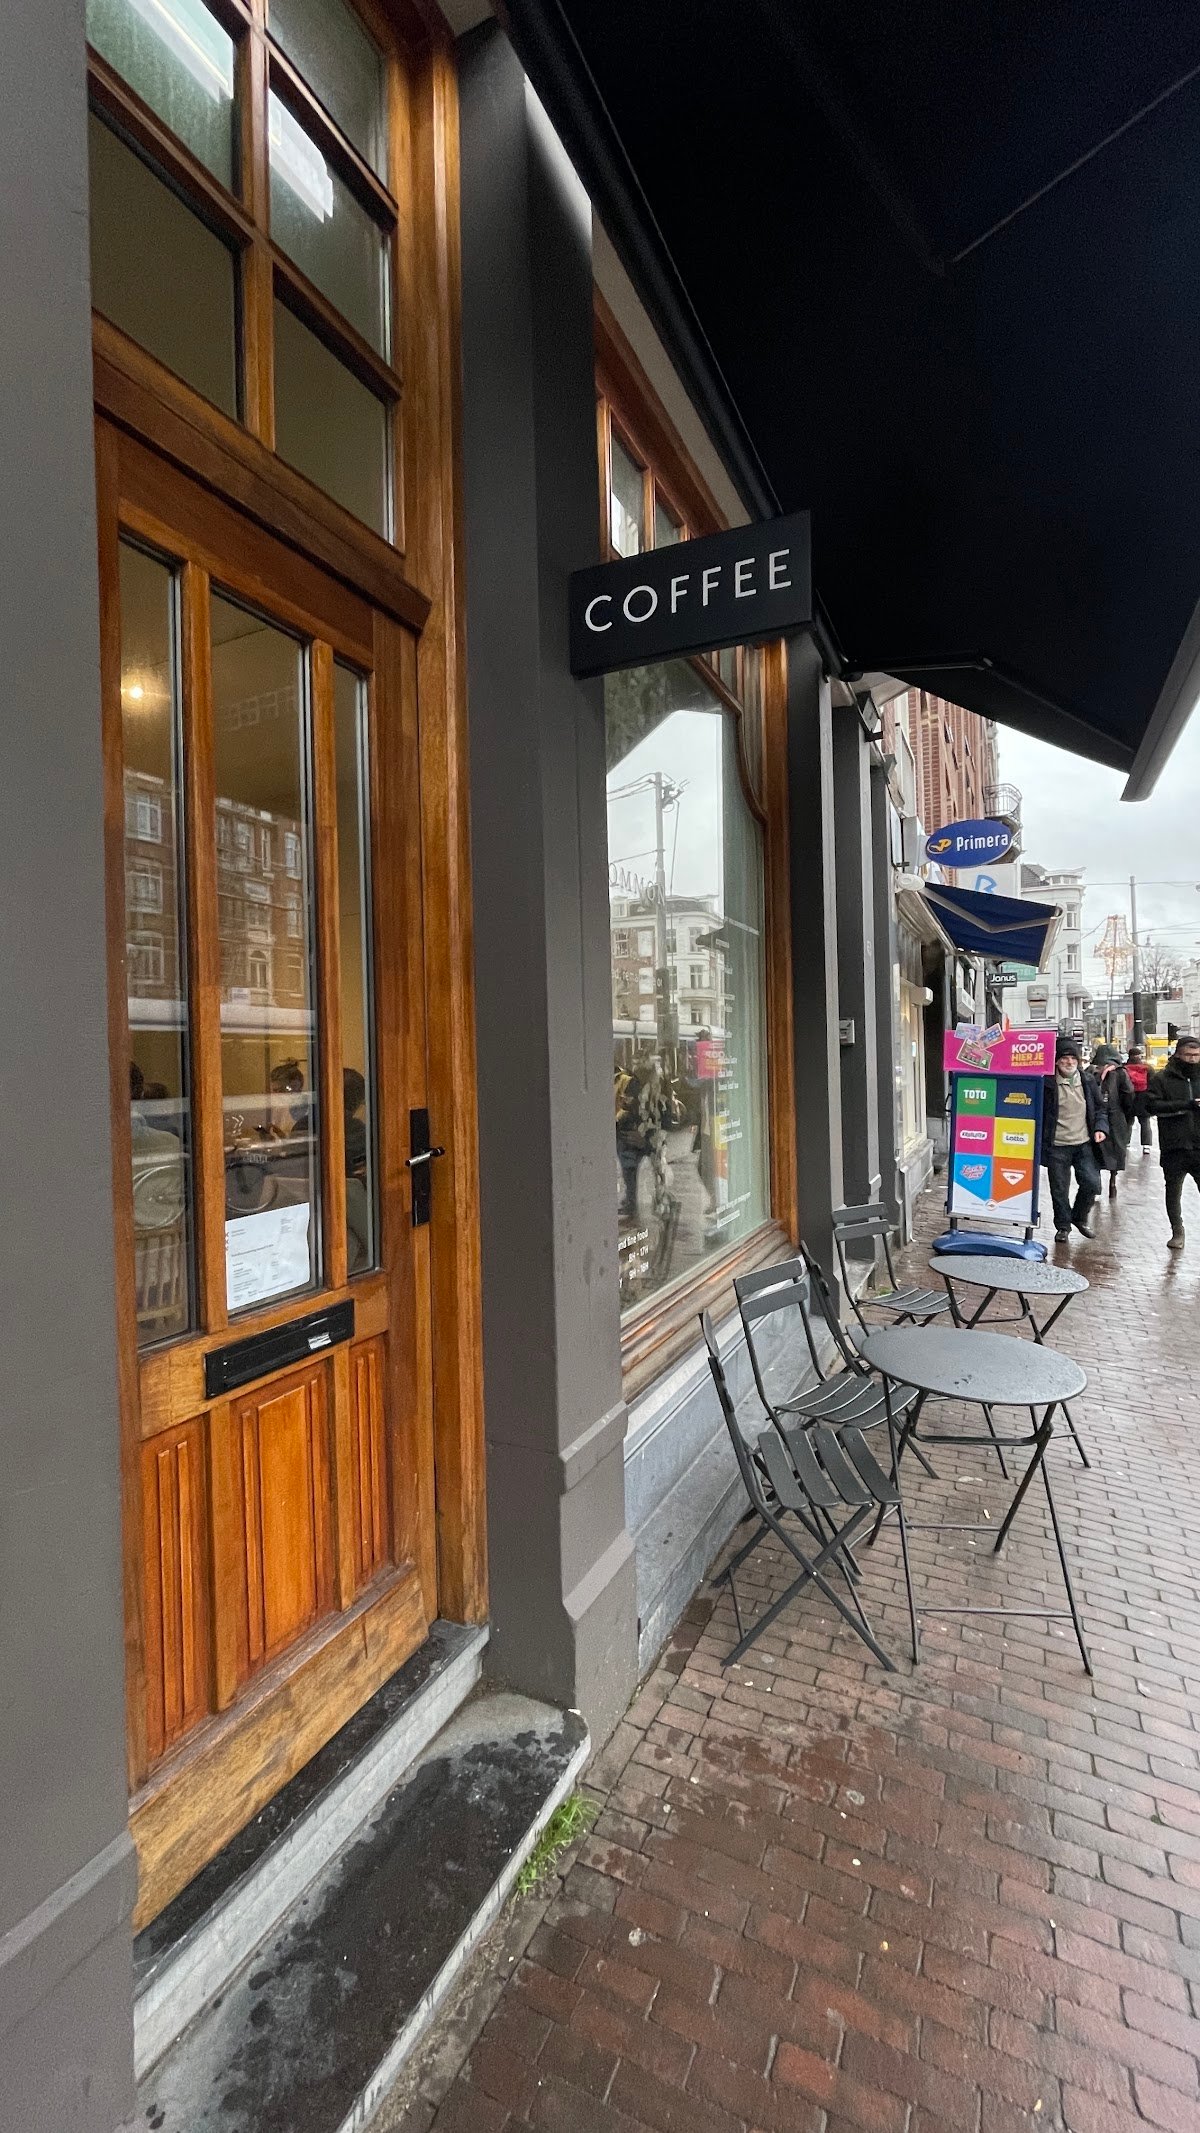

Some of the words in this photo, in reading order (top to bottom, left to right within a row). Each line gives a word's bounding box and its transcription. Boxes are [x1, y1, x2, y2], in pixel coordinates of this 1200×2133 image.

[584, 548, 792, 632] COFFEE
[956, 833, 1009, 852] Primera
[990, 974, 1017, 983] Janus
[1011, 1043, 1045, 1054] KOOP
[1011, 1053, 1033, 1062] HIER
[1034, 1052, 1045, 1061] JE
[963, 1090, 987, 1100] TOTO
